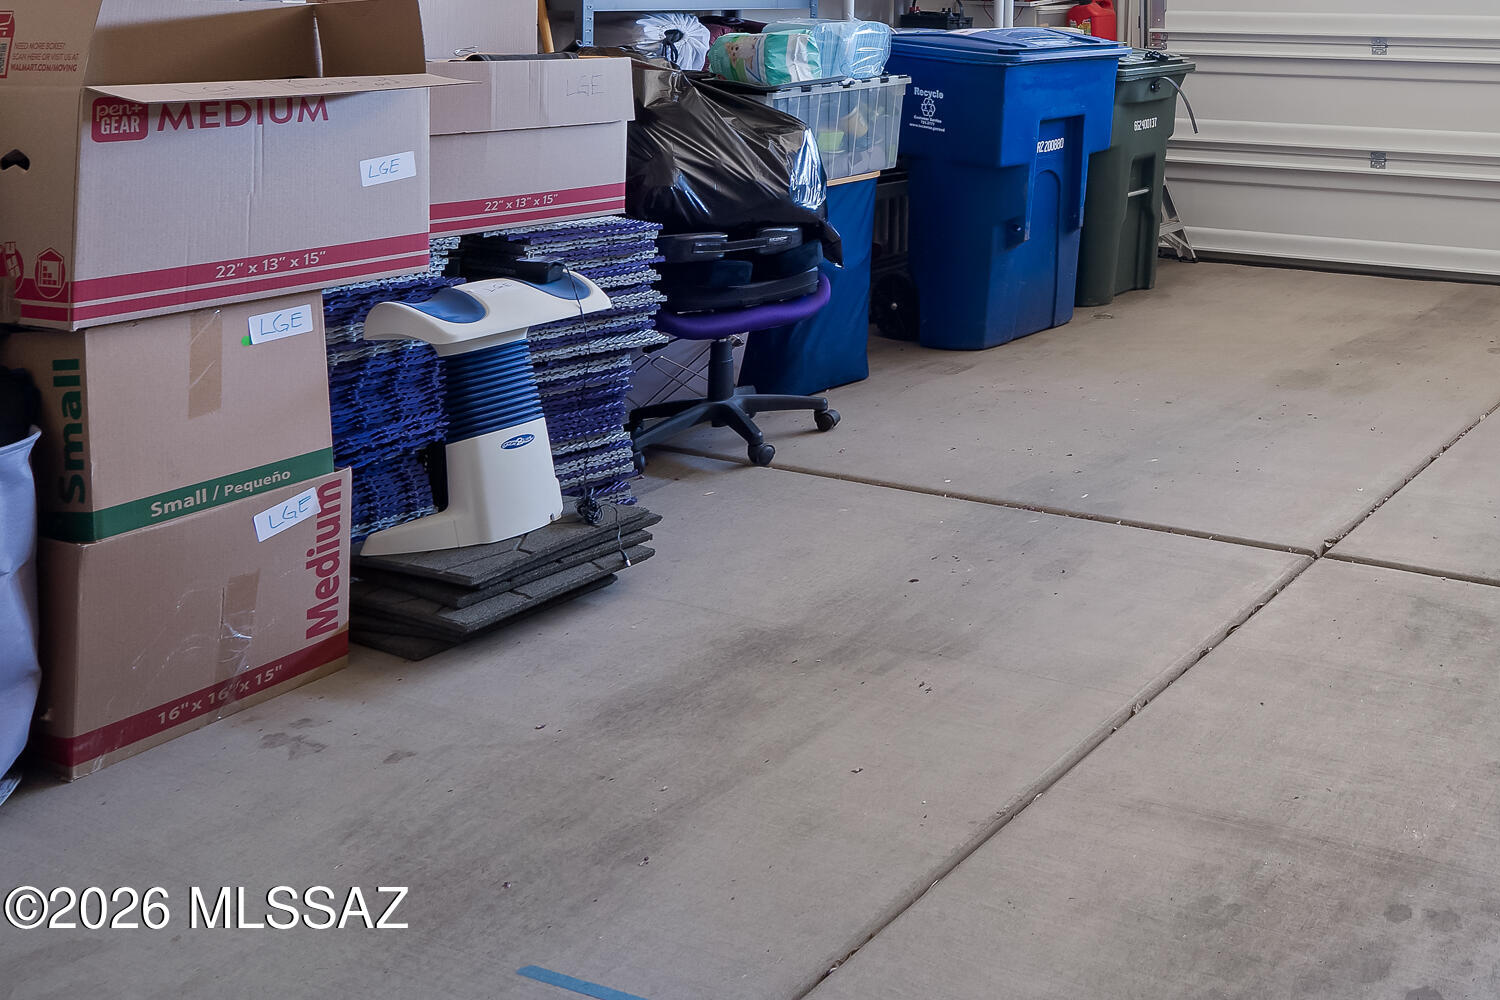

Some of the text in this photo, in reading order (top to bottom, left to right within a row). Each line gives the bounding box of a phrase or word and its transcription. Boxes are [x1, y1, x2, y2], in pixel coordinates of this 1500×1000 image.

[914, 86, 944, 99] Recycle
[100, 115, 140, 135] GEAR
[157, 96, 329, 132] MEDIUM
[368, 158, 401, 179] LGE
[484, 193, 559, 212] 22" x 13" x 15"
[216, 250, 327, 279] 22" x 13" x 15"
[260, 312, 303, 336] LGE
[52, 357, 86, 505] Small
[150, 467, 292, 518] Small / Pequeño
[268, 496, 313, 530] LGE
[305, 478, 343, 640] Medium
[157, 702, 189, 725] 16"
[190, 700, 202, 712] x
[254, 664, 283, 686] 15"
